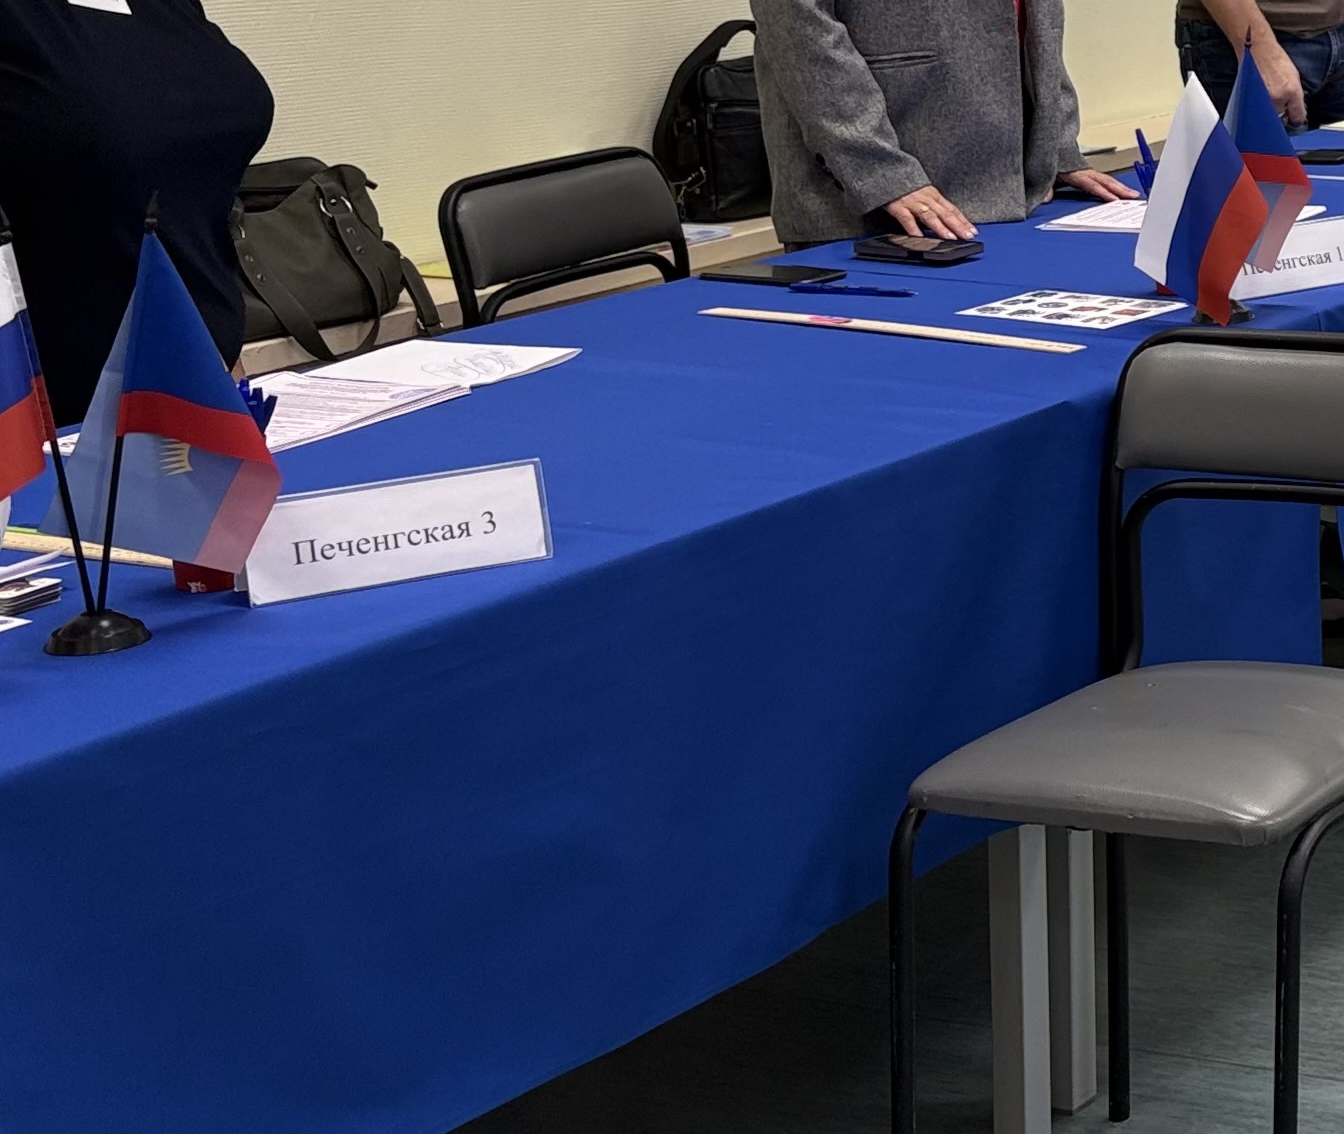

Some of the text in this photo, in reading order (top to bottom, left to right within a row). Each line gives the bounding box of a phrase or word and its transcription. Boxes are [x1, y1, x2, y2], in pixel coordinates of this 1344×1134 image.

[1243, 245, 1344, 276] Пенгская 1
[292, 510, 497, 566] Печенгская 3
